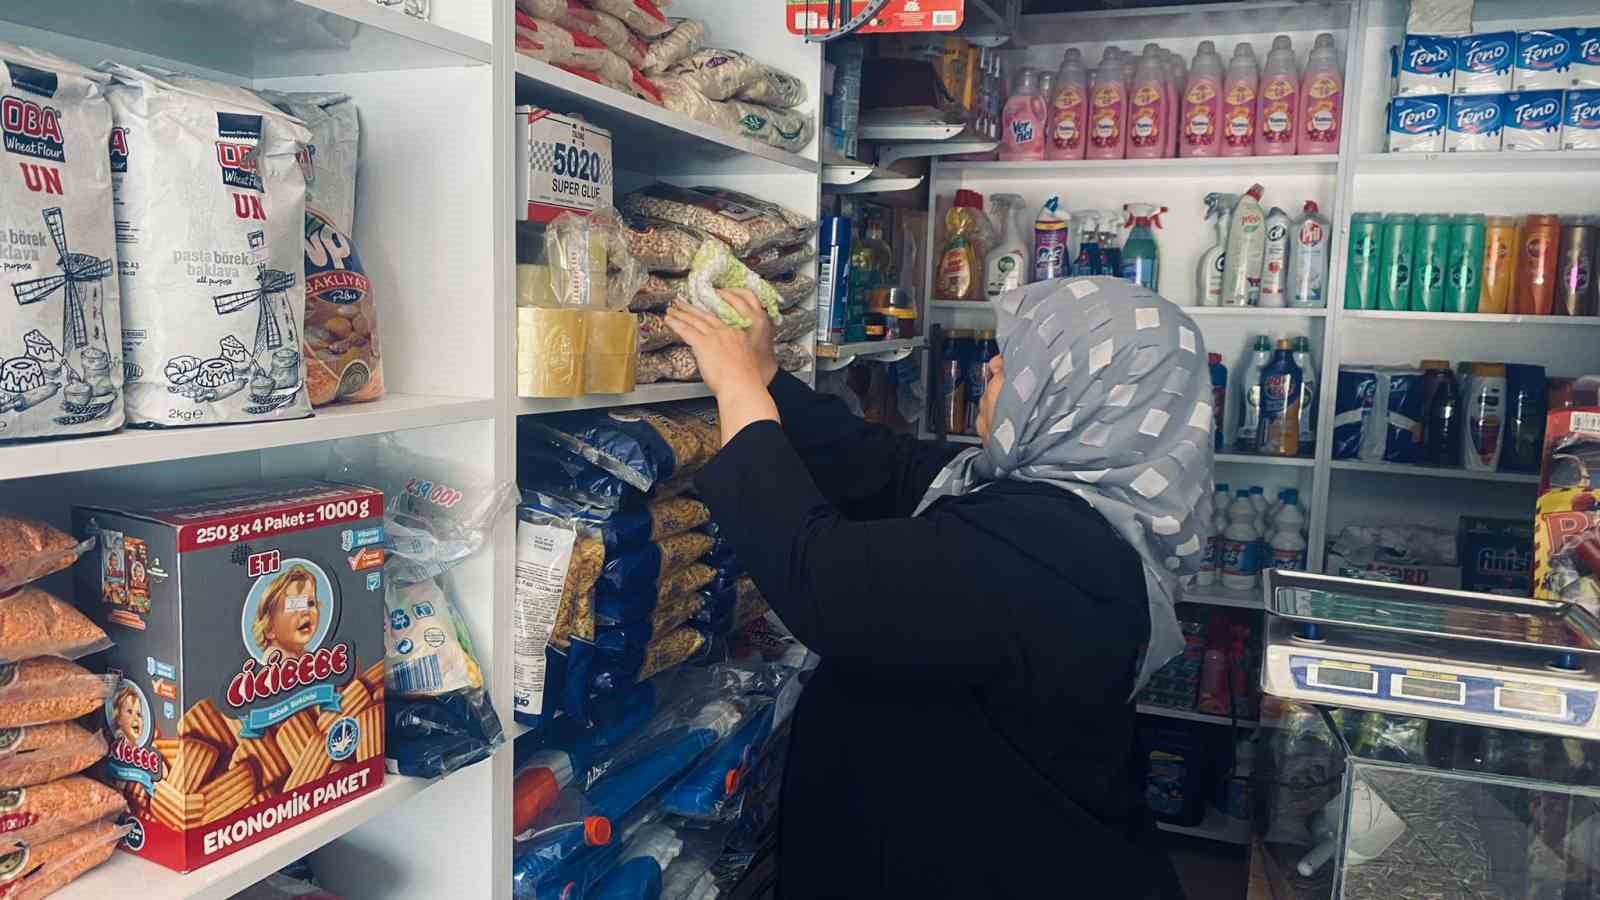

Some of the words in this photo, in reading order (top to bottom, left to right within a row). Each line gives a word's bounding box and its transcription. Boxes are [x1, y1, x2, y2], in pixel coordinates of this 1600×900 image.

[1410, 47, 1448, 67] Teno
[1466, 46, 1504, 66] Teno
[1522, 43, 1564, 64] Teno
[2, 97, 63, 143] OBA
[1398, 107, 1436, 128] Teno
[1457, 107, 1495, 127] Teno
[1515, 103, 1555, 123] Teno
[6, 136, 38, 155] Wheat
[38, 141, 63, 159] Flour
[553, 143, 600, 183] 5020
[20, 162, 64, 195] UN
[552, 178, 580, 197] SUPER
[10, 229, 47, 247] börek
[173, 250, 212, 265] pasta
[214, 250, 249, 266] börek
[187, 264, 239, 279] baklava
[208, 278, 233, 287] purpose
[197, 526, 227, 544] 250
[229, 528, 240, 542] g
[241, 524, 250, 535] x
[252, 519, 263, 534] 4
[265, 512, 305, 532] Paket
[306, 513, 315, 523] =
[317, 500, 358, 521] 1000
[359, 499, 369, 518] g
[203, 793, 311, 855] EKONOMİK
[314, 768, 371, 807] PAKET
